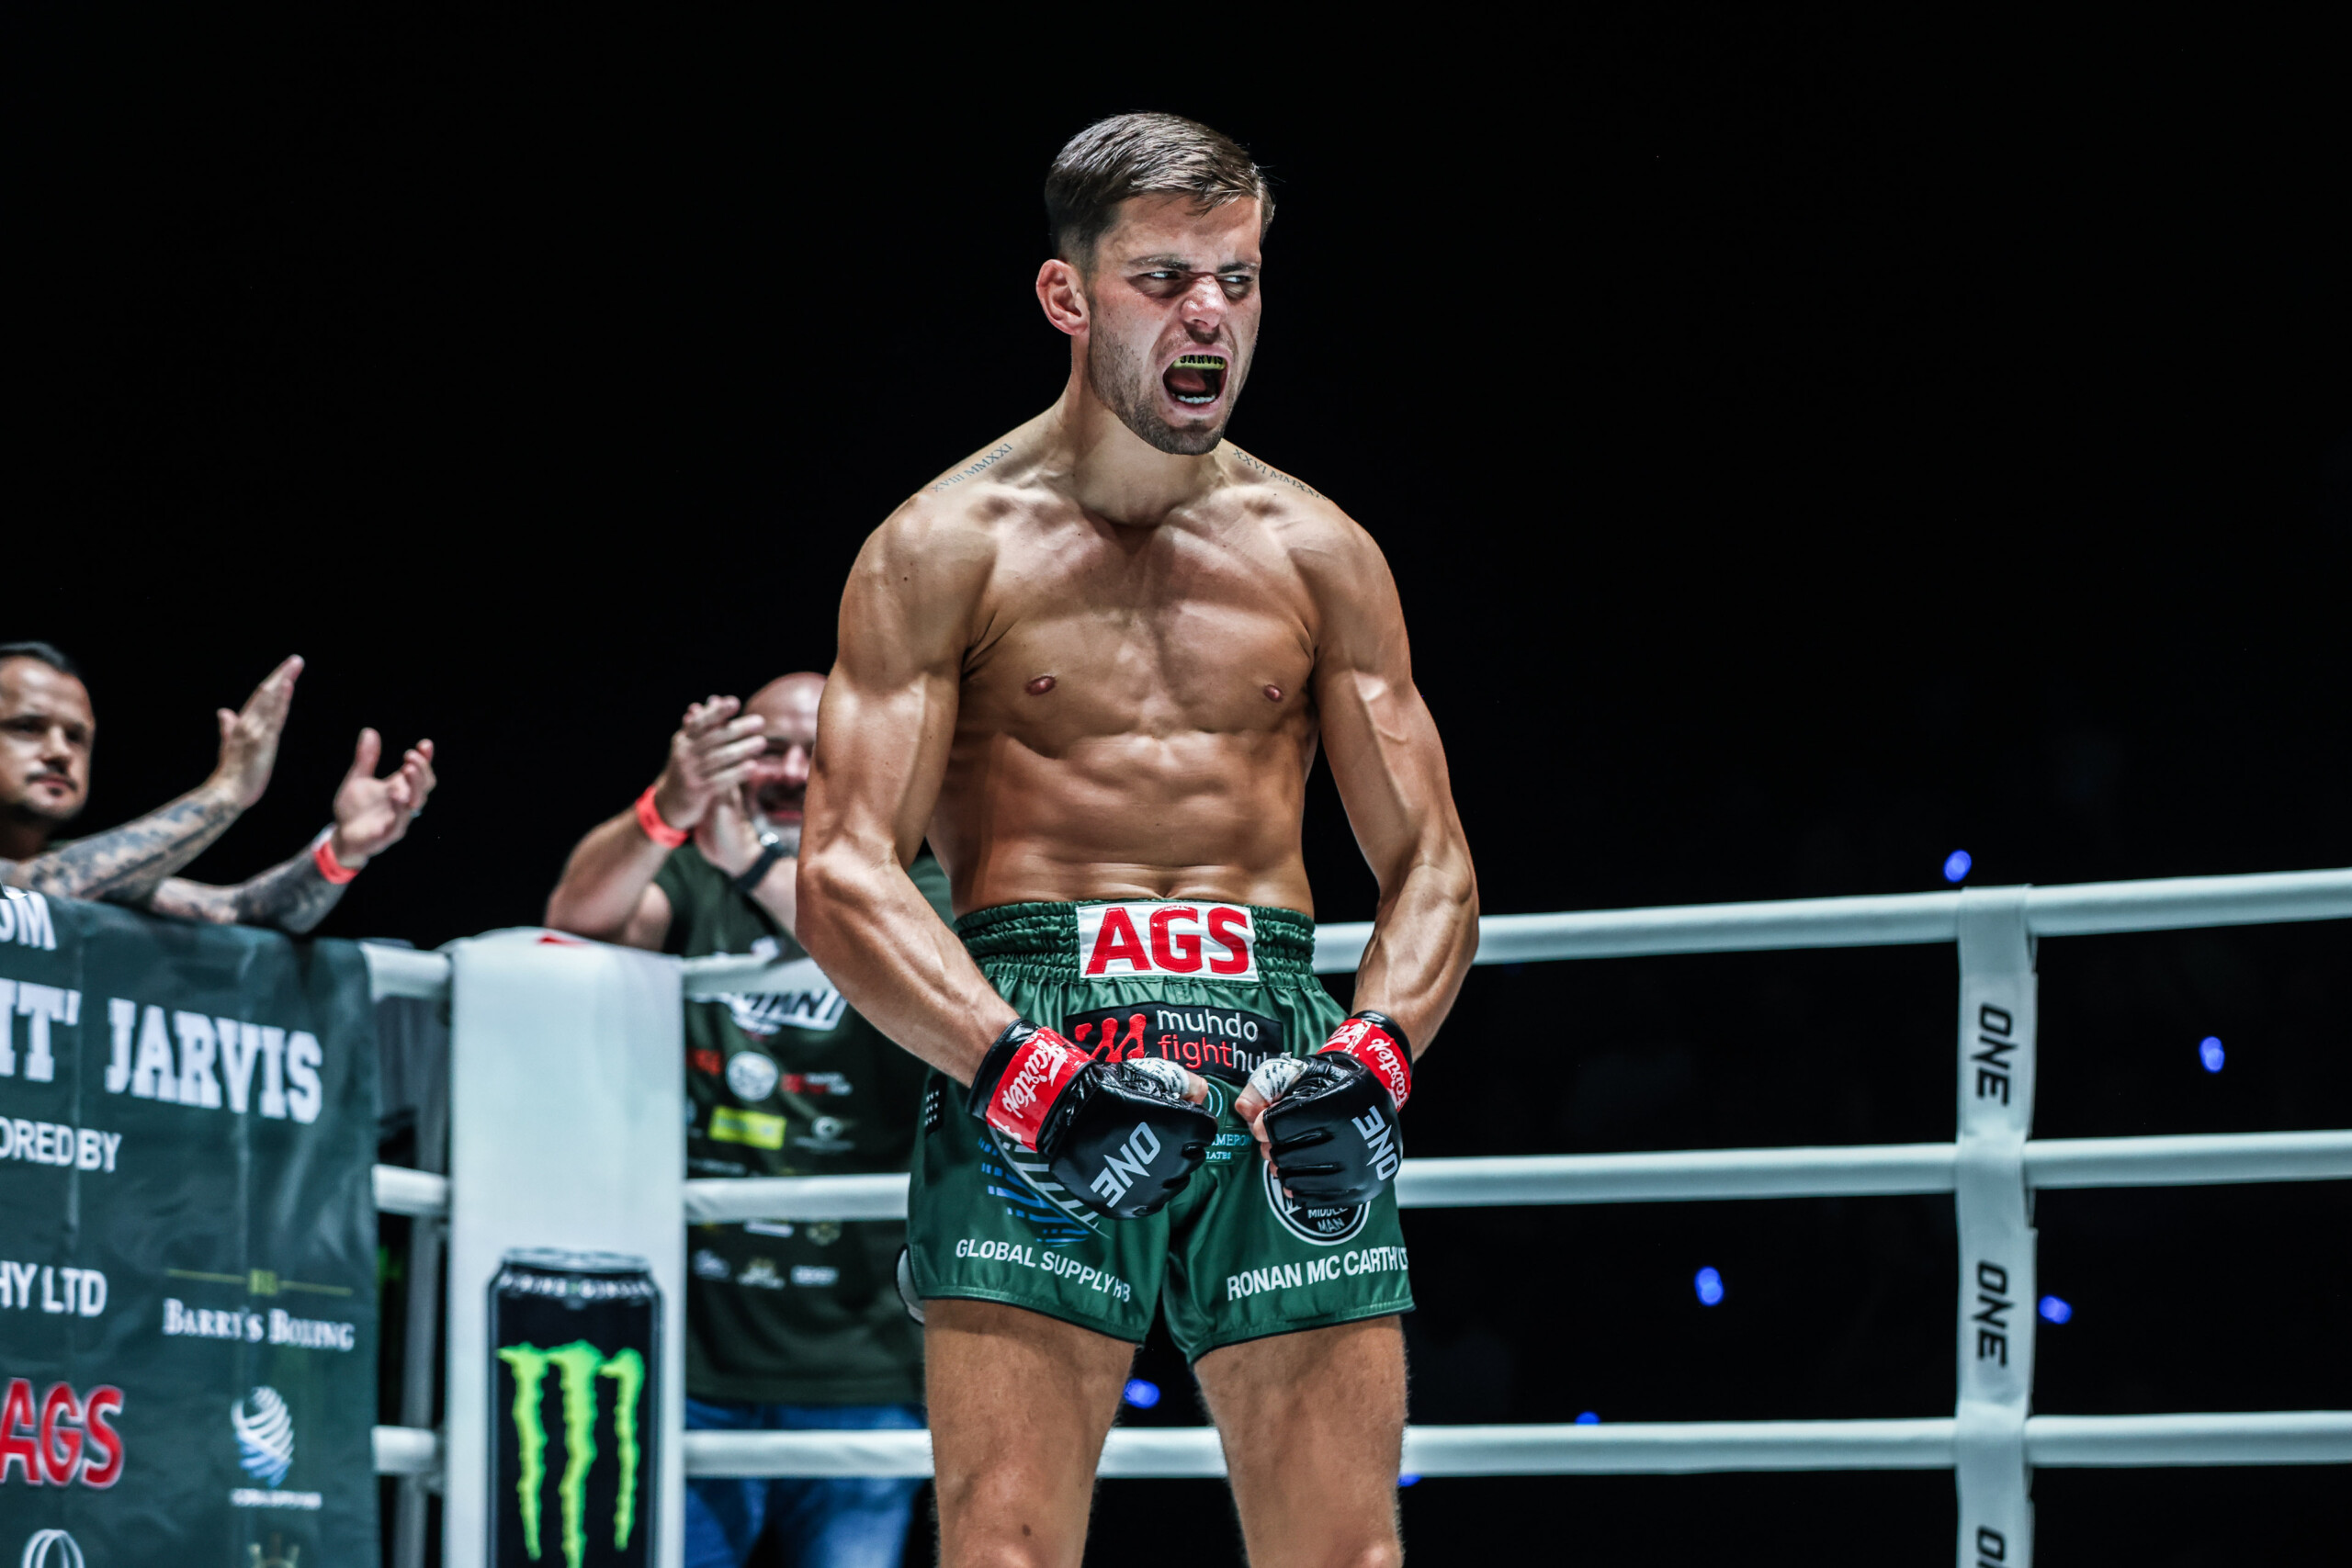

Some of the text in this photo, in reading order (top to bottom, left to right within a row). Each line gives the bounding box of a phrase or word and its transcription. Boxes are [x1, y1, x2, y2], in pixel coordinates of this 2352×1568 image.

[1180, 355, 1224, 365] JARVIS
[964, 443, 1012, 476] MMXXI
[1233, 448, 1267, 474] XXVI
[1085, 905, 1250, 976] AGS
[105, 998, 322, 1124] JARVIS
[1157, 1009, 1259, 1042] muhdo
[1970, 1002, 2018, 1107] ONE
[1001, 1039, 1069, 1119] Fairtex
[1090, 1122, 1161, 1209] ONE
[1351, 1105, 1398, 1181] ONE
[41, 1266, 107, 1317] LTD
[956, 1239, 1036, 1268] GLOBAL
[1040, 1251, 1114, 1294] SUPPLY
[1227, 1263, 1303, 1301] RONAN
[1306, 1255, 1340, 1284] MC
[1971, 1259, 2016, 1367] ONE
[0, 1378, 124, 1489] AGS
